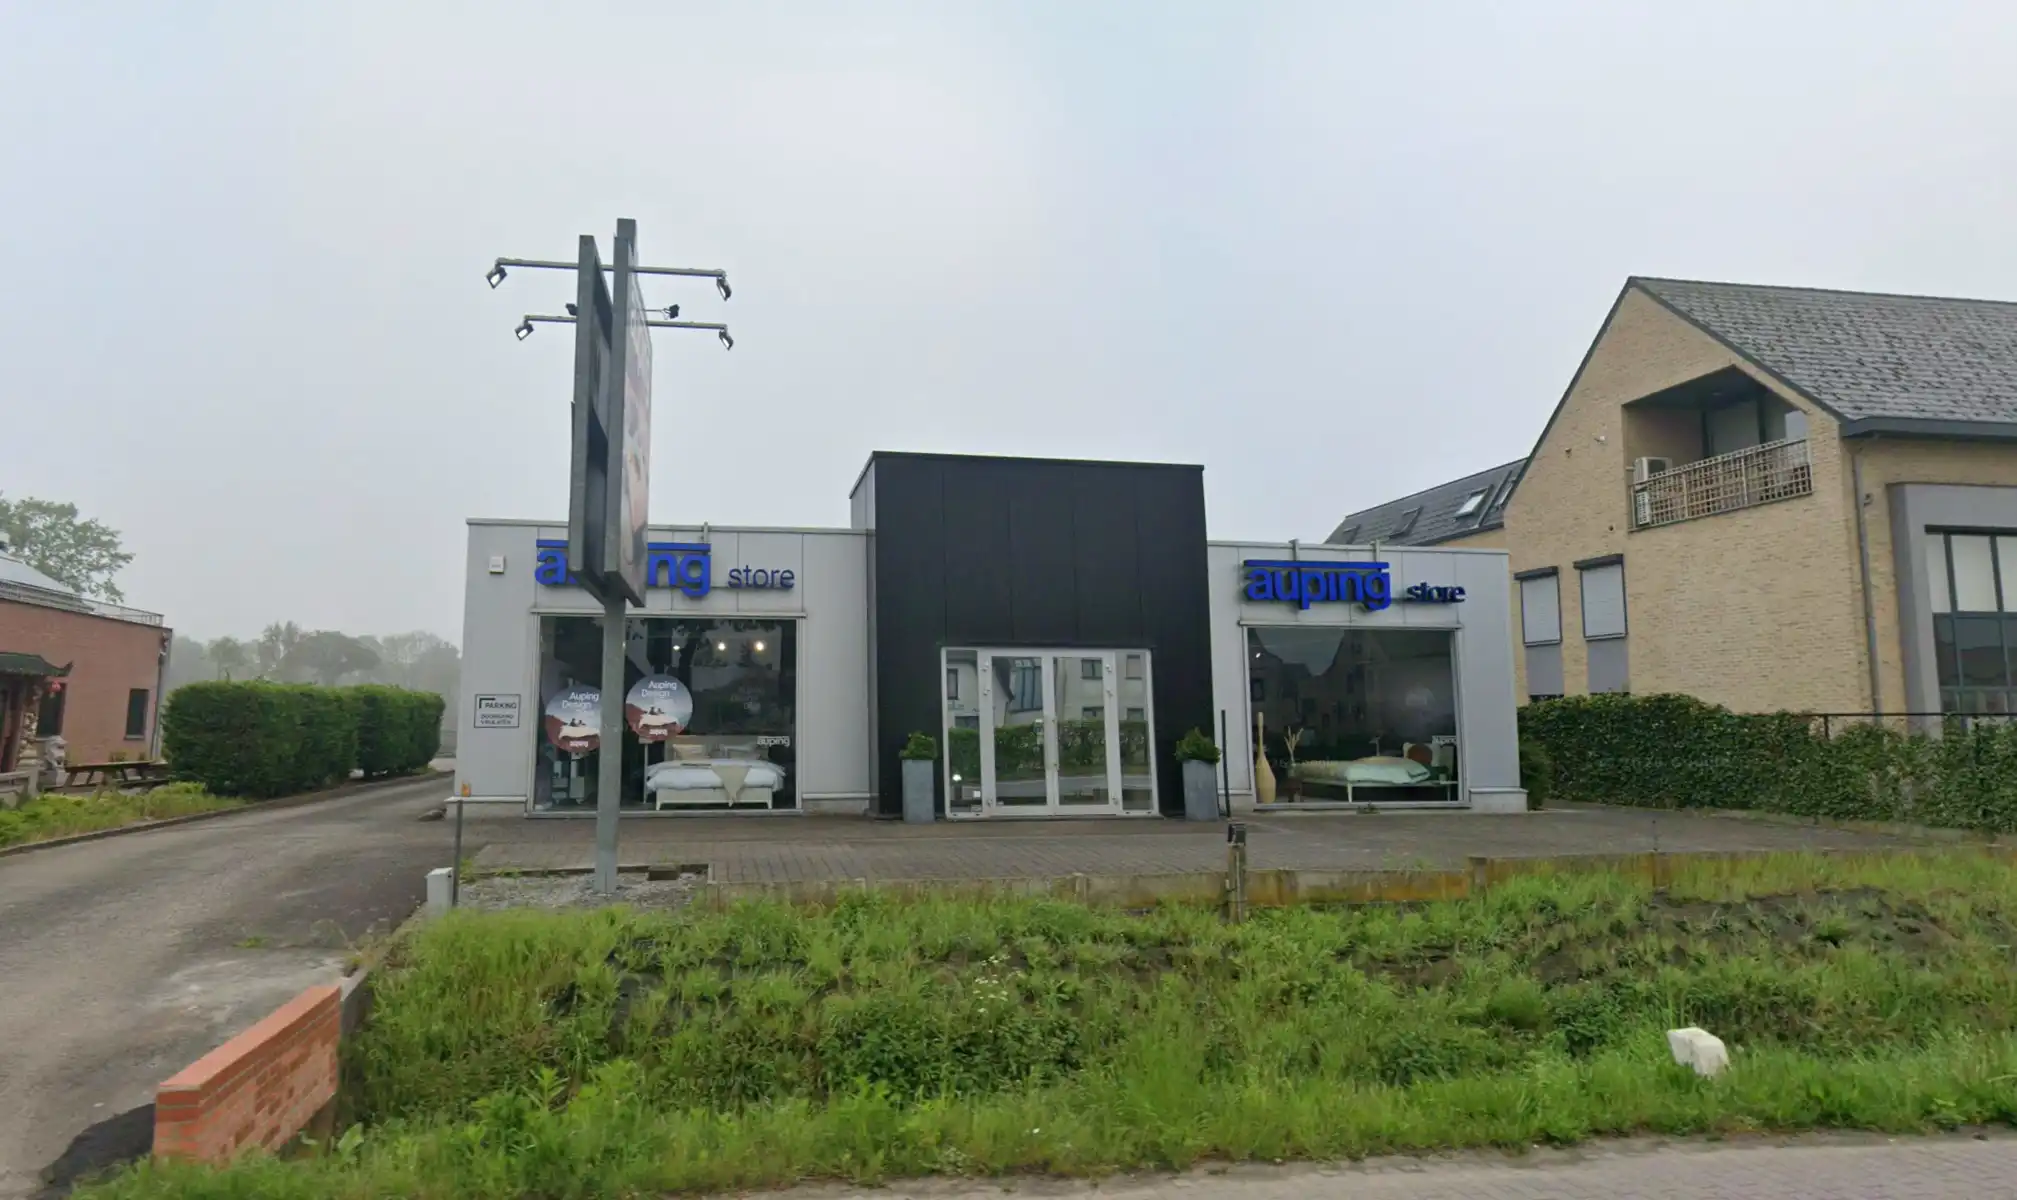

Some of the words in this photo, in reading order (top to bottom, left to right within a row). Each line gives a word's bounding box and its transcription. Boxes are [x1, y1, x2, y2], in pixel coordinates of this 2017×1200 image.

[535, 540, 712, 597] ang
[728, 564, 795, 589] store
[1243, 560, 1392, 611] auping
[1406, 582, 1466, 603] store
[647, 680, 678, 691] Auping
[569, 692, 600, 703] Auping
[757, 736, 790, 748] auping
